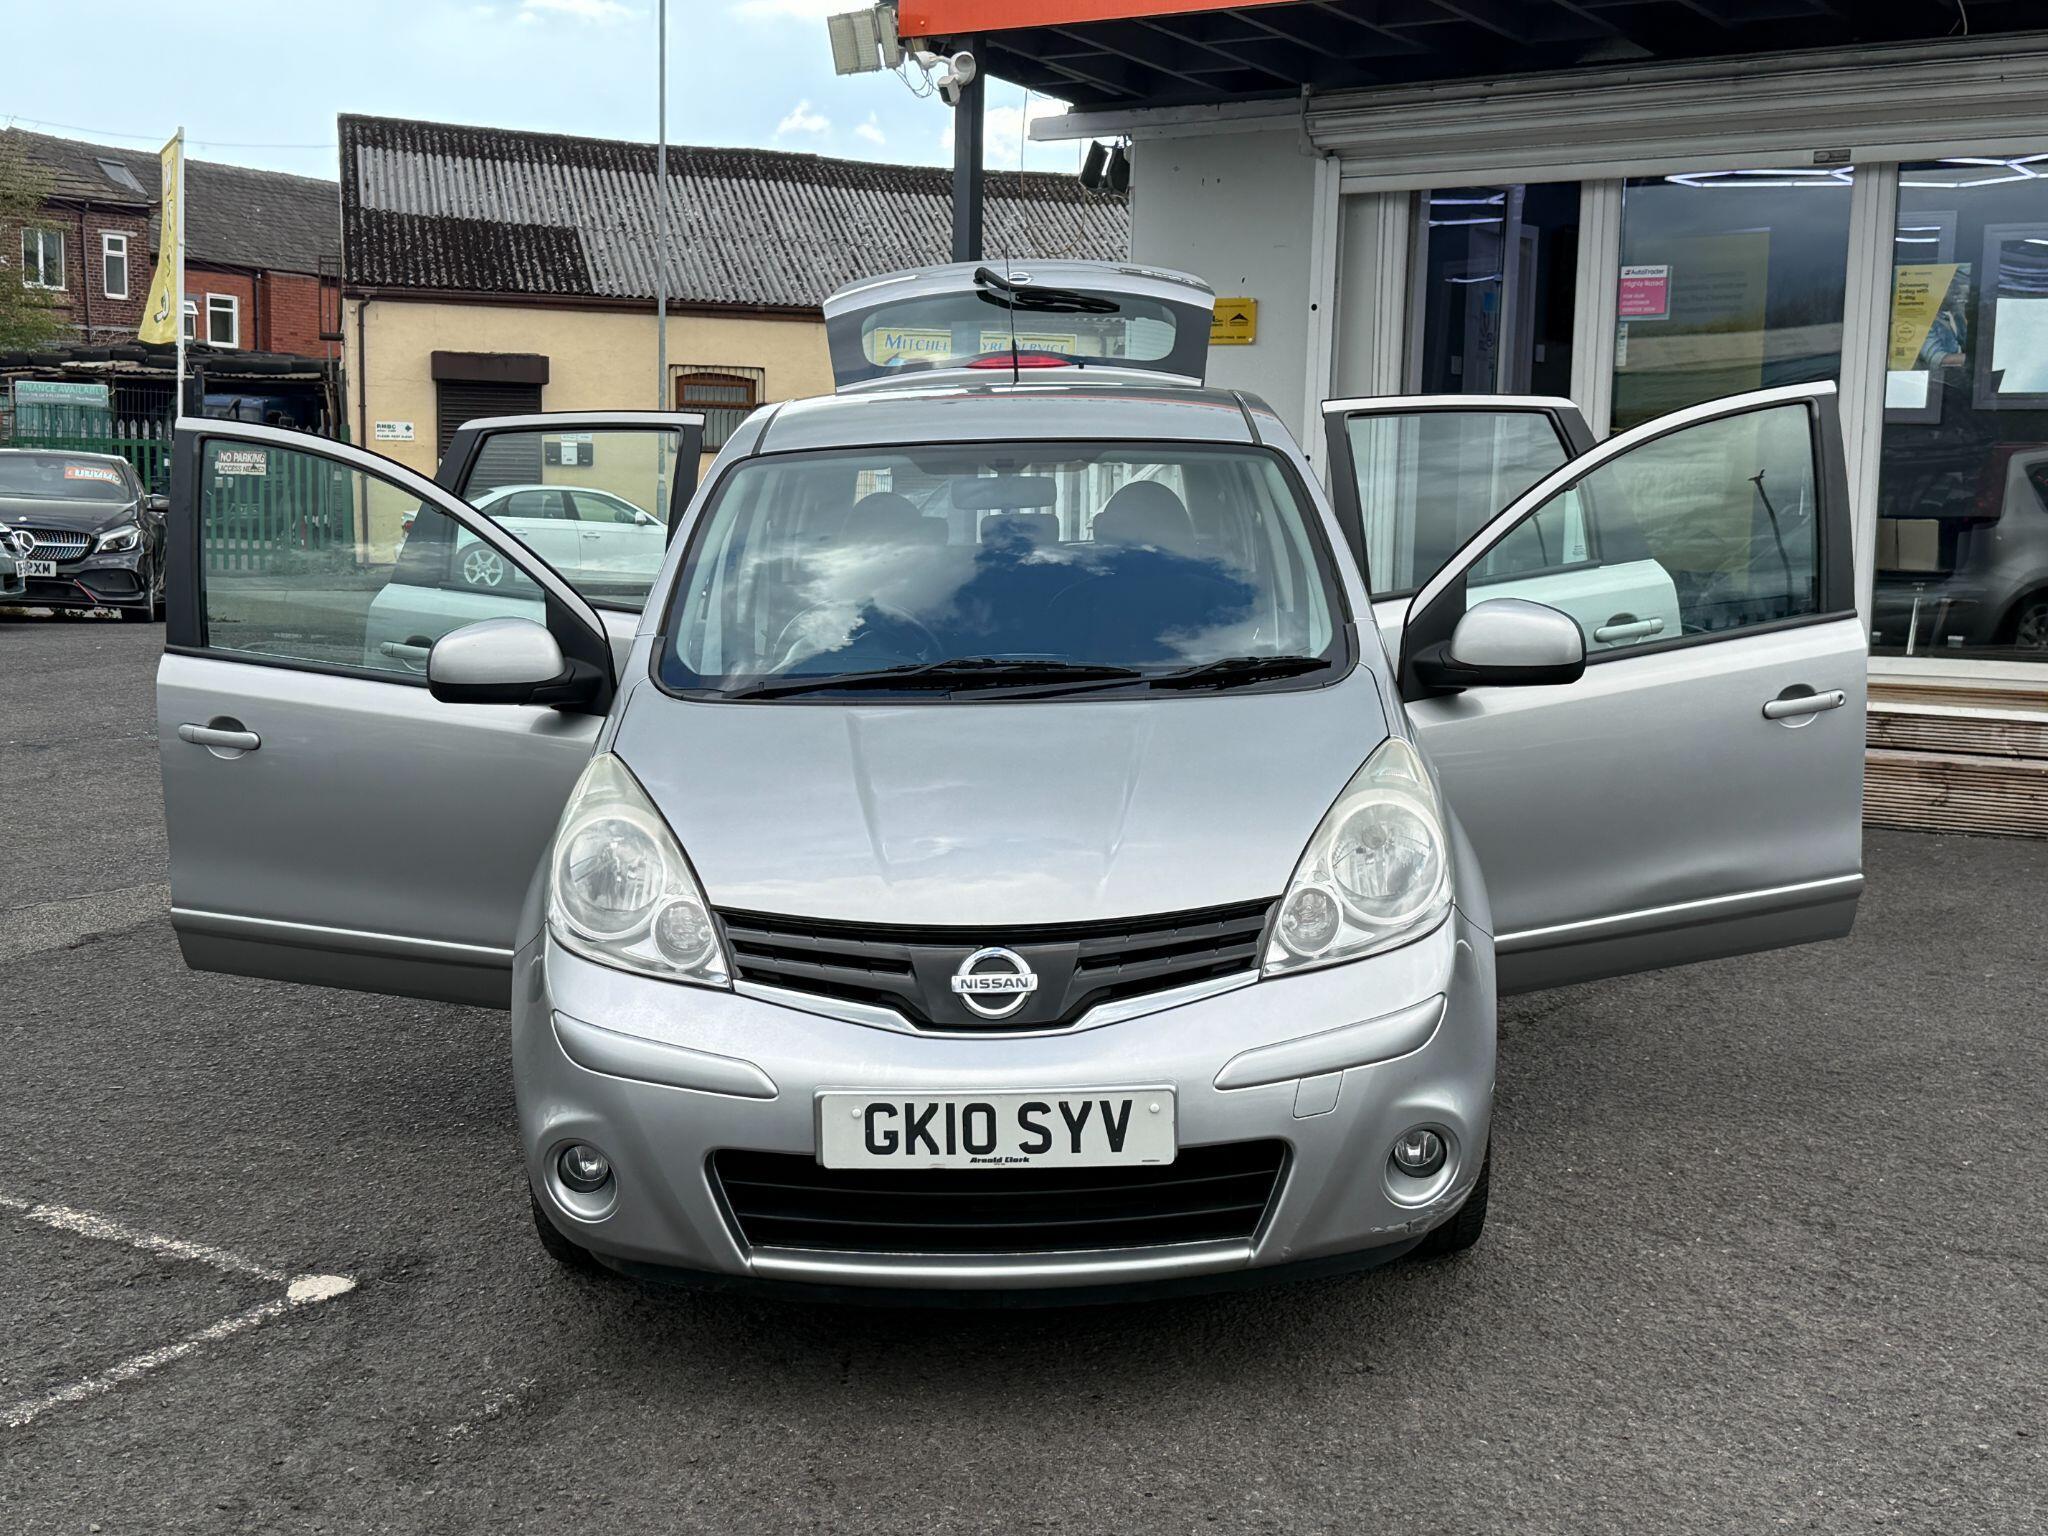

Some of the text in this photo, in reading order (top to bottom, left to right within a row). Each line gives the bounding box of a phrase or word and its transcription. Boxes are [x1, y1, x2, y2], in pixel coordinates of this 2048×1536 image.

[220, 452, 265, 463] NO PARKING
[960, 977, 1030, 990] NISSAN
[864, 1099, 1133, 1156] GK10 SYV
[969, 1156, 1030, 1164] Arnold Clark
